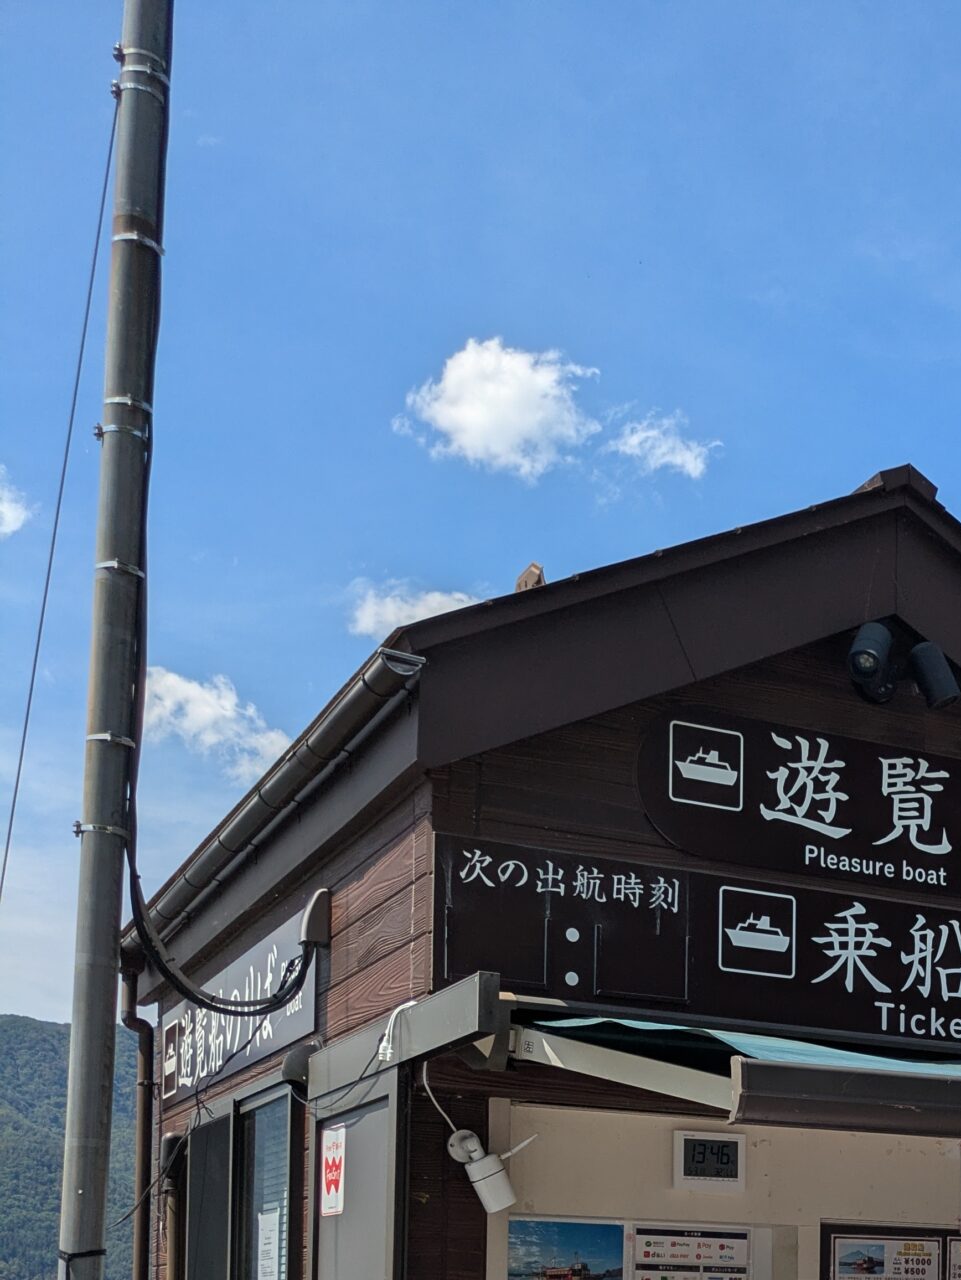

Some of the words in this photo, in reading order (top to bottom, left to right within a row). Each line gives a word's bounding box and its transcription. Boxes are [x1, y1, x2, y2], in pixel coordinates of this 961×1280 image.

[805, 845, 895, 878] Pleasure
[903, 860, 947, 886] boat
[459, 850, 680, 913] 次の出航時刻
[904, 1258, 932, 1266] ¥1000
[904, 1267, 927, 1276] ¥500
